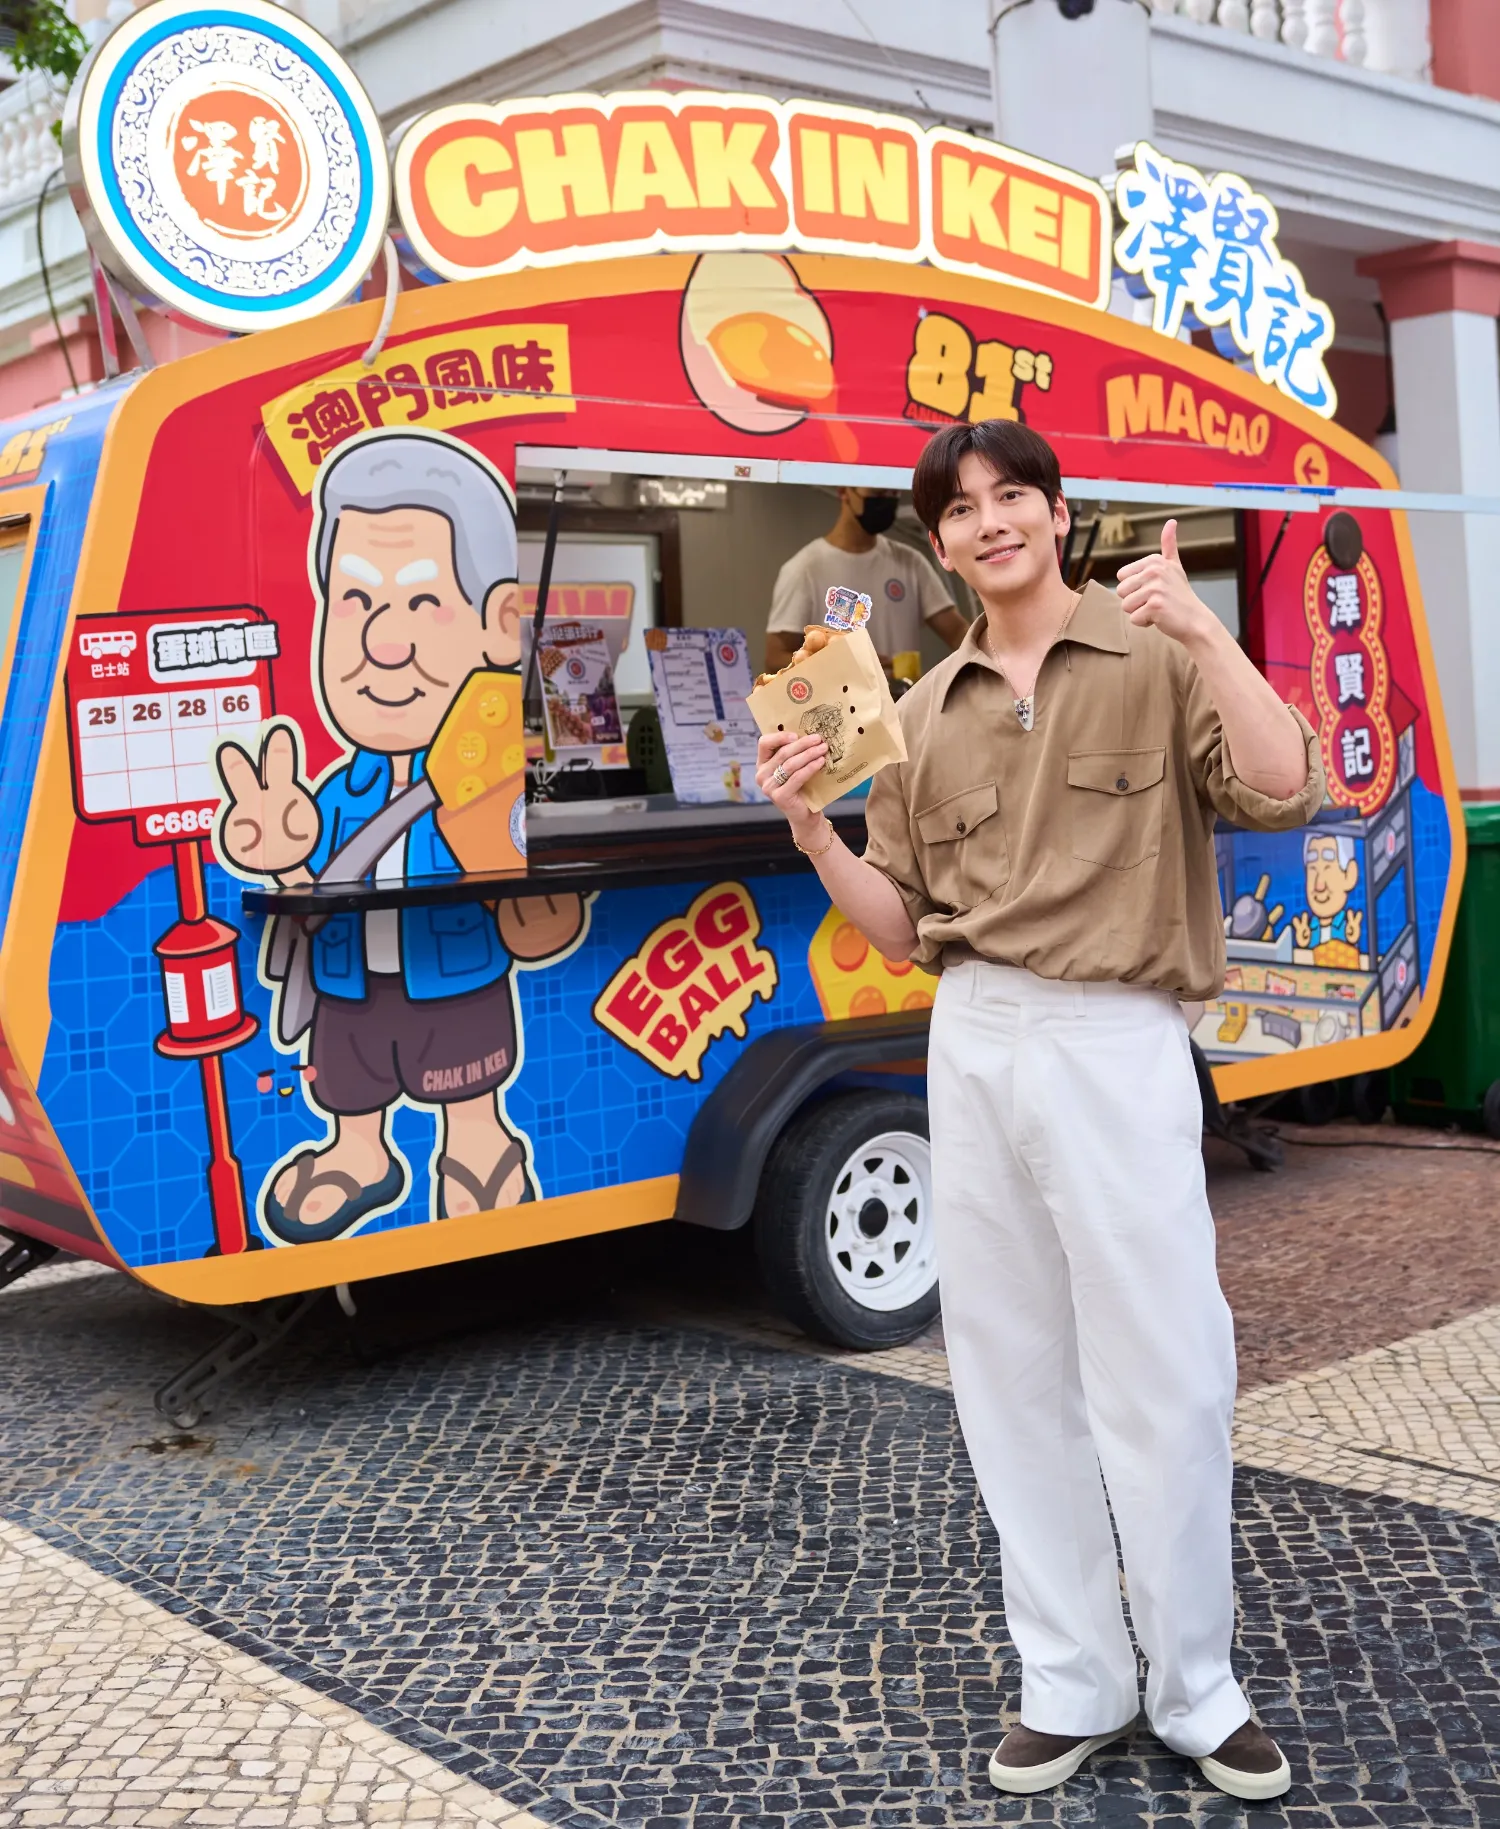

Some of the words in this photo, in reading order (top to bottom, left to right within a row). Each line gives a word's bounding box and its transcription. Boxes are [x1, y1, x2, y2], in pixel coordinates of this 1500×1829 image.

[181, 116, 288, 221] 澤賢記
[424, 121, 778, 239] CHAK
[800, 129, 909, 225] IN
[940, 153, 1092, 280] KEI
[1125, 158, 1328, 407] 澤賢記
[1106, 385, 1270, 457] MACAO
[89, 706, 117, 726] 25
[133, 703, 162, 722] 26
[178, 699, 207, 717] 28
[222, 695, 250, 713] 66
[91, 662, 130, 678] 巴士站
[1327, 574, 1374, 780] 澤賢記
[605, 892, 751, 1037] EGG
[646, 944, 766, 1062] BALL
[422, 1066, 464, 1092] CHAK
[466, 1060, 482, 1084] IN
[484, 1048, 508, 1077] KEI
